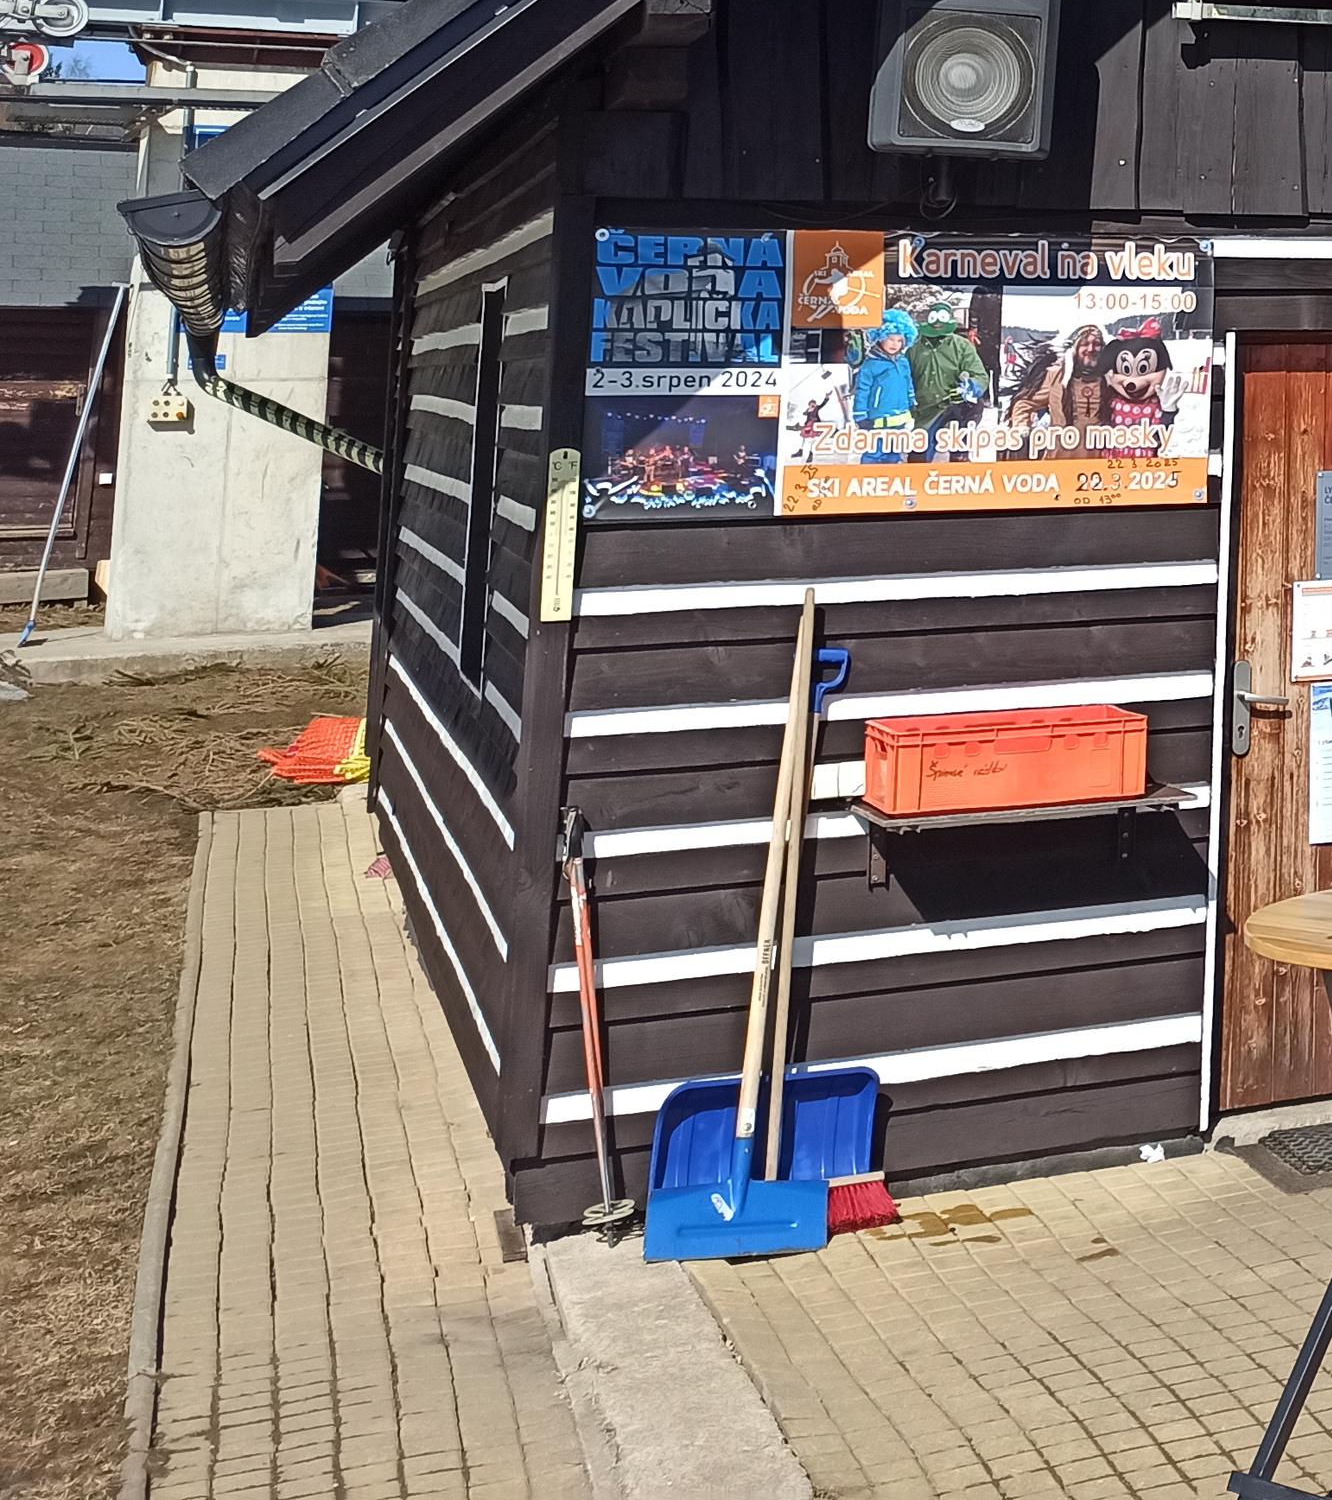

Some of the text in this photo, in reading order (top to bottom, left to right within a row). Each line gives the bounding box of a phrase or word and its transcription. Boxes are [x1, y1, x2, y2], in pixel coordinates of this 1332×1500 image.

[899, 240, 1196, 281] Karneval na vleku
[596, 267, 782, 298] VODA
[1073, 290, 1197, 312] 13:00-15:00
[590, 331, 779, 363] FESTIVAL
[721, 370, 777, 388] 2024
[813, 417, 1174, 461] Zdarma skipas pro masky
[807, 476, 840, 498] SKI
[845, 475, 917, 498] AREAL
[924, 469, 995, 496] ČERNÁ
[1002, 471, 1060, 493] VODA
